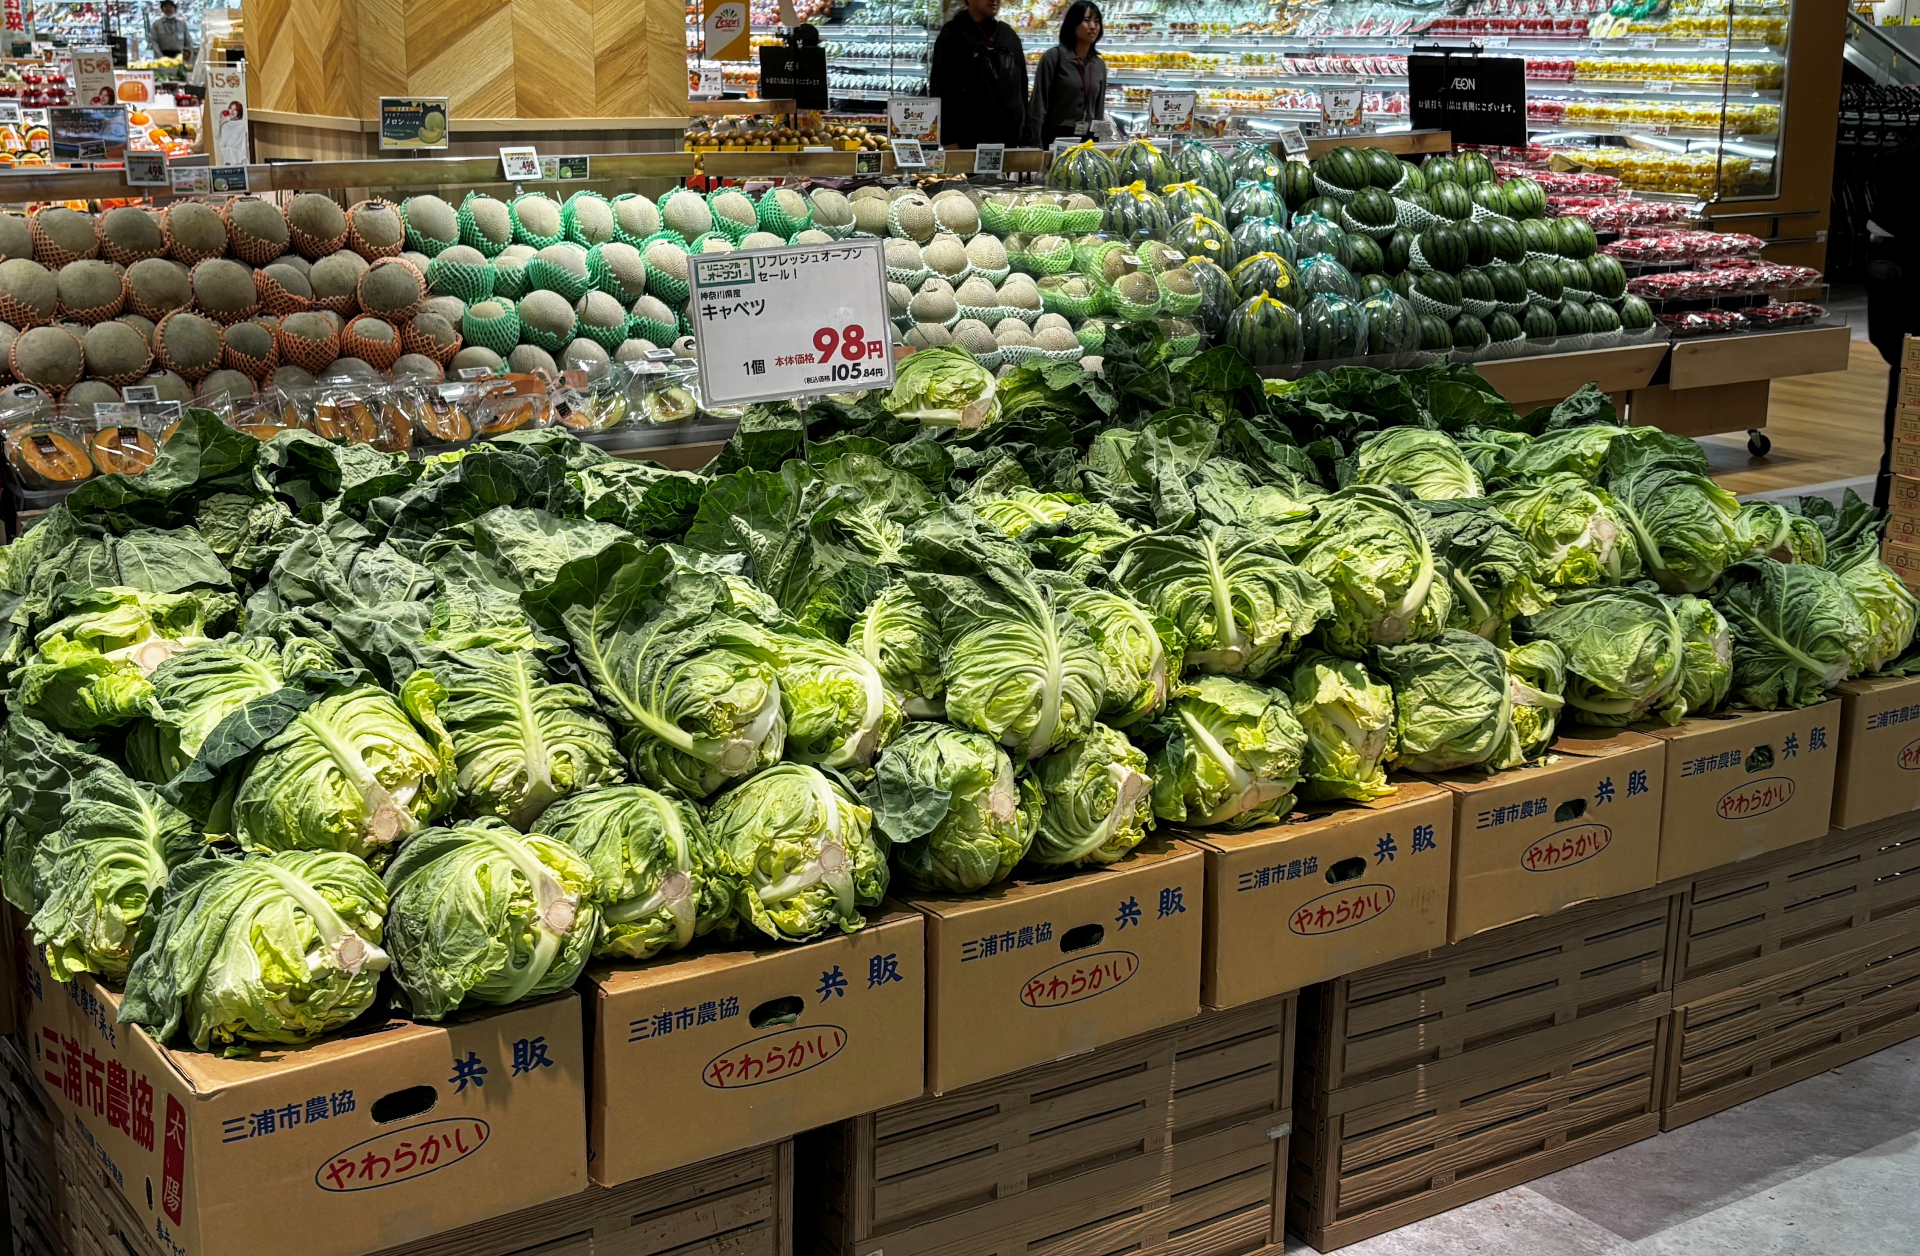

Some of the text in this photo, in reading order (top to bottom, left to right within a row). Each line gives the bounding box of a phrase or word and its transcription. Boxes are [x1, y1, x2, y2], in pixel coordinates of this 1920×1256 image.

[715, 16, 741, 29] Zespri
[1451, 78, 1475, 90] AEON
[384, 118, 405, 126] メロン
[1418, 99, 1516, 113] お値打ち品は裏側にございます。
[148, 165, 163, 176] 498
[707, 262, 741, 271] リニューアル
[756, 248, 863, 269] リフレッシュオープン
[700, 289, 742, 301] 神奈川県産
[702, 299, 766, 321] キャベツ
[743, 359, 766, 376] 1個
[1680, 727, 1828, 778] 三浦市農協 共販
[1476, 769, 1649, 829] 三浦市農協 共販
[1720, 782, 1792, 817] やわらかい
[1237, 824, 1437, 892] 三浦市農協 共販
[1526, 829, 1609, 869] やわらかい
[961, 886, 1187, 962] 三浦市農協 共販
[1294, 890, 1391, 933] やわらかい
[628, 953, 904, 1043] 三浦市農協 共販
[1025, 957, 1133, 1006] やわらかい
[709, 1031, 841, 1087] やわらかい
[43, 1026, 155, 1152] 三浦市農協
[222, 1036, 555, 1143] 三浦市農協 共販
[326, 1124, 485, 1190] やわらかい
